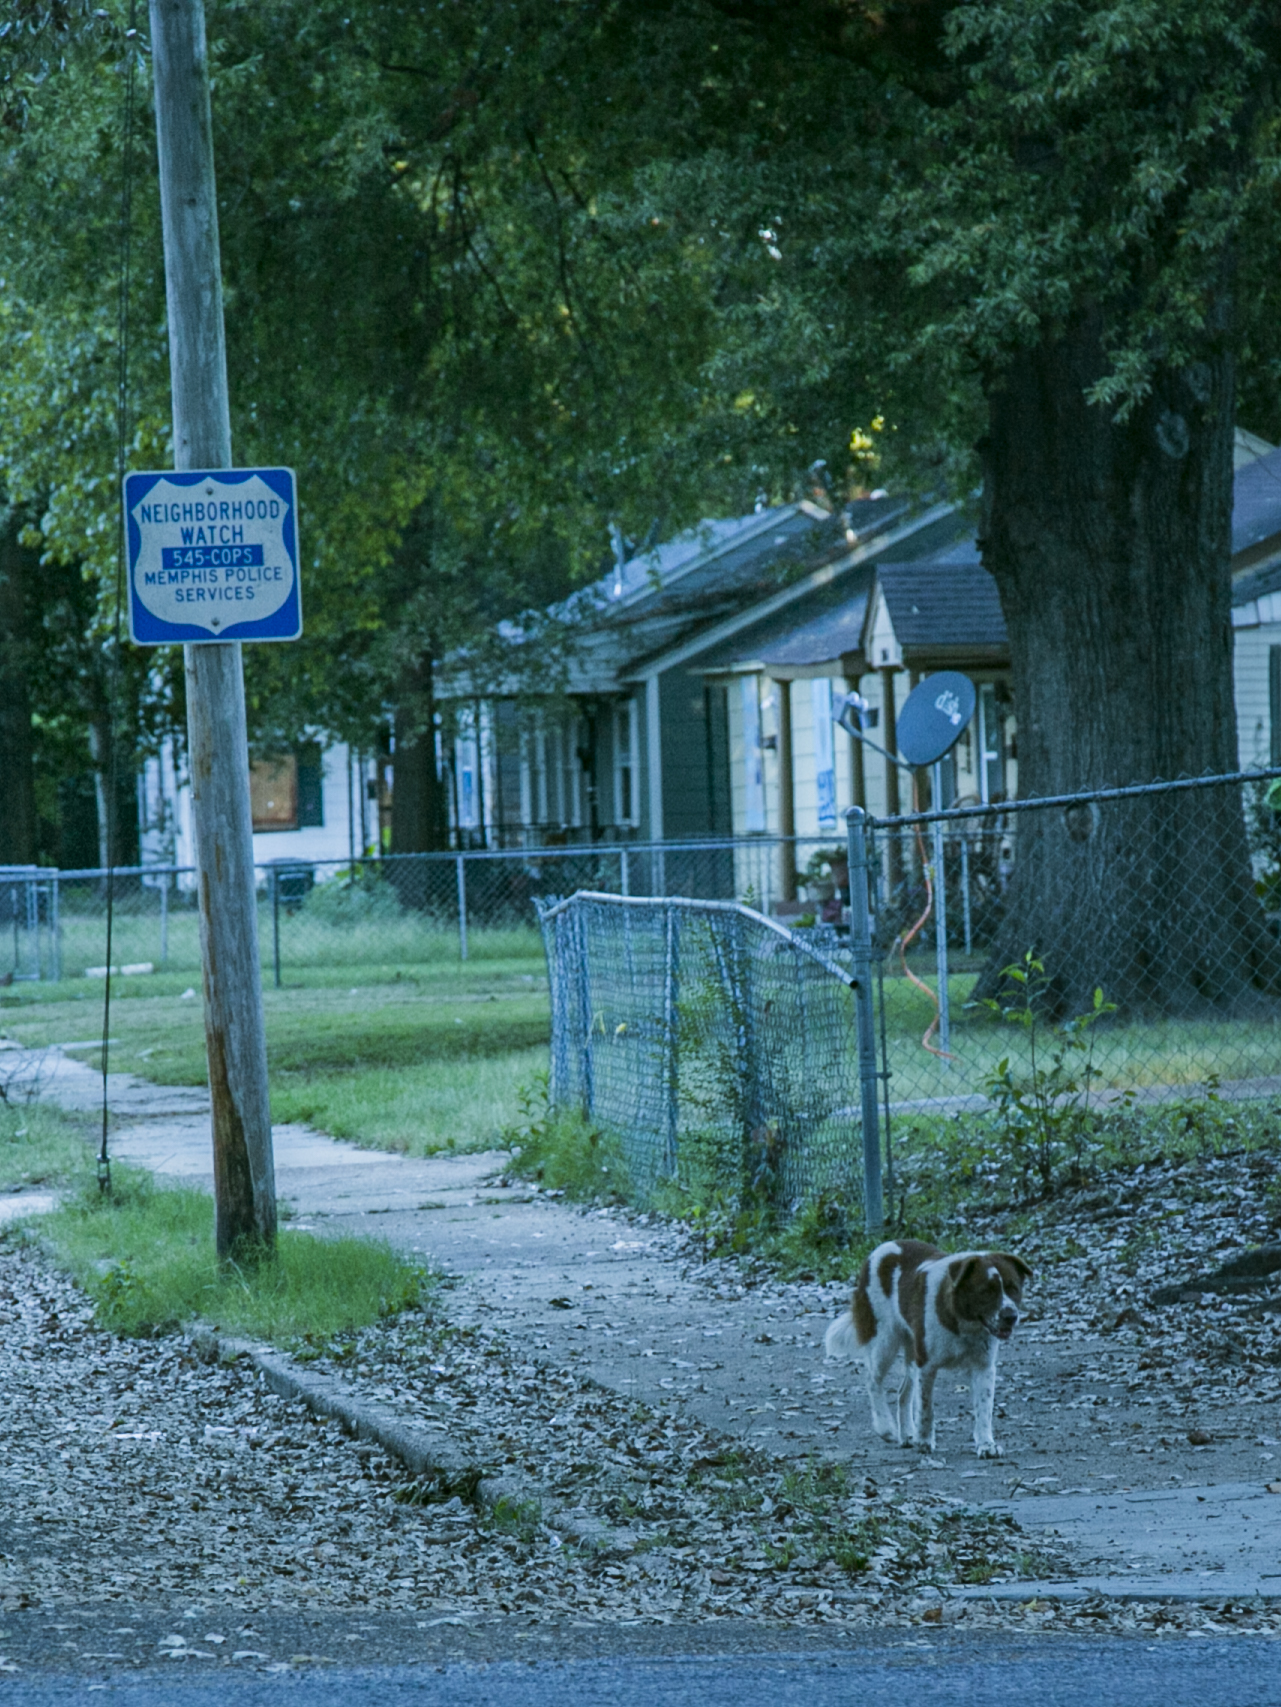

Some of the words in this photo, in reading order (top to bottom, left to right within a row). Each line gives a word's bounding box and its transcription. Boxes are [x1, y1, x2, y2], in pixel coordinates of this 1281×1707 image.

[141, 500, 280, 523] NEIGHBORHOOD
[180, 525, 244, 545] WATCH
[173, 548, 253, 567] 545-COPS
[145, 569, 219, 585] MEMPHIS
[225, 567, 283, 583] POLICE
[175, 586, 255, 602] SERVICES
